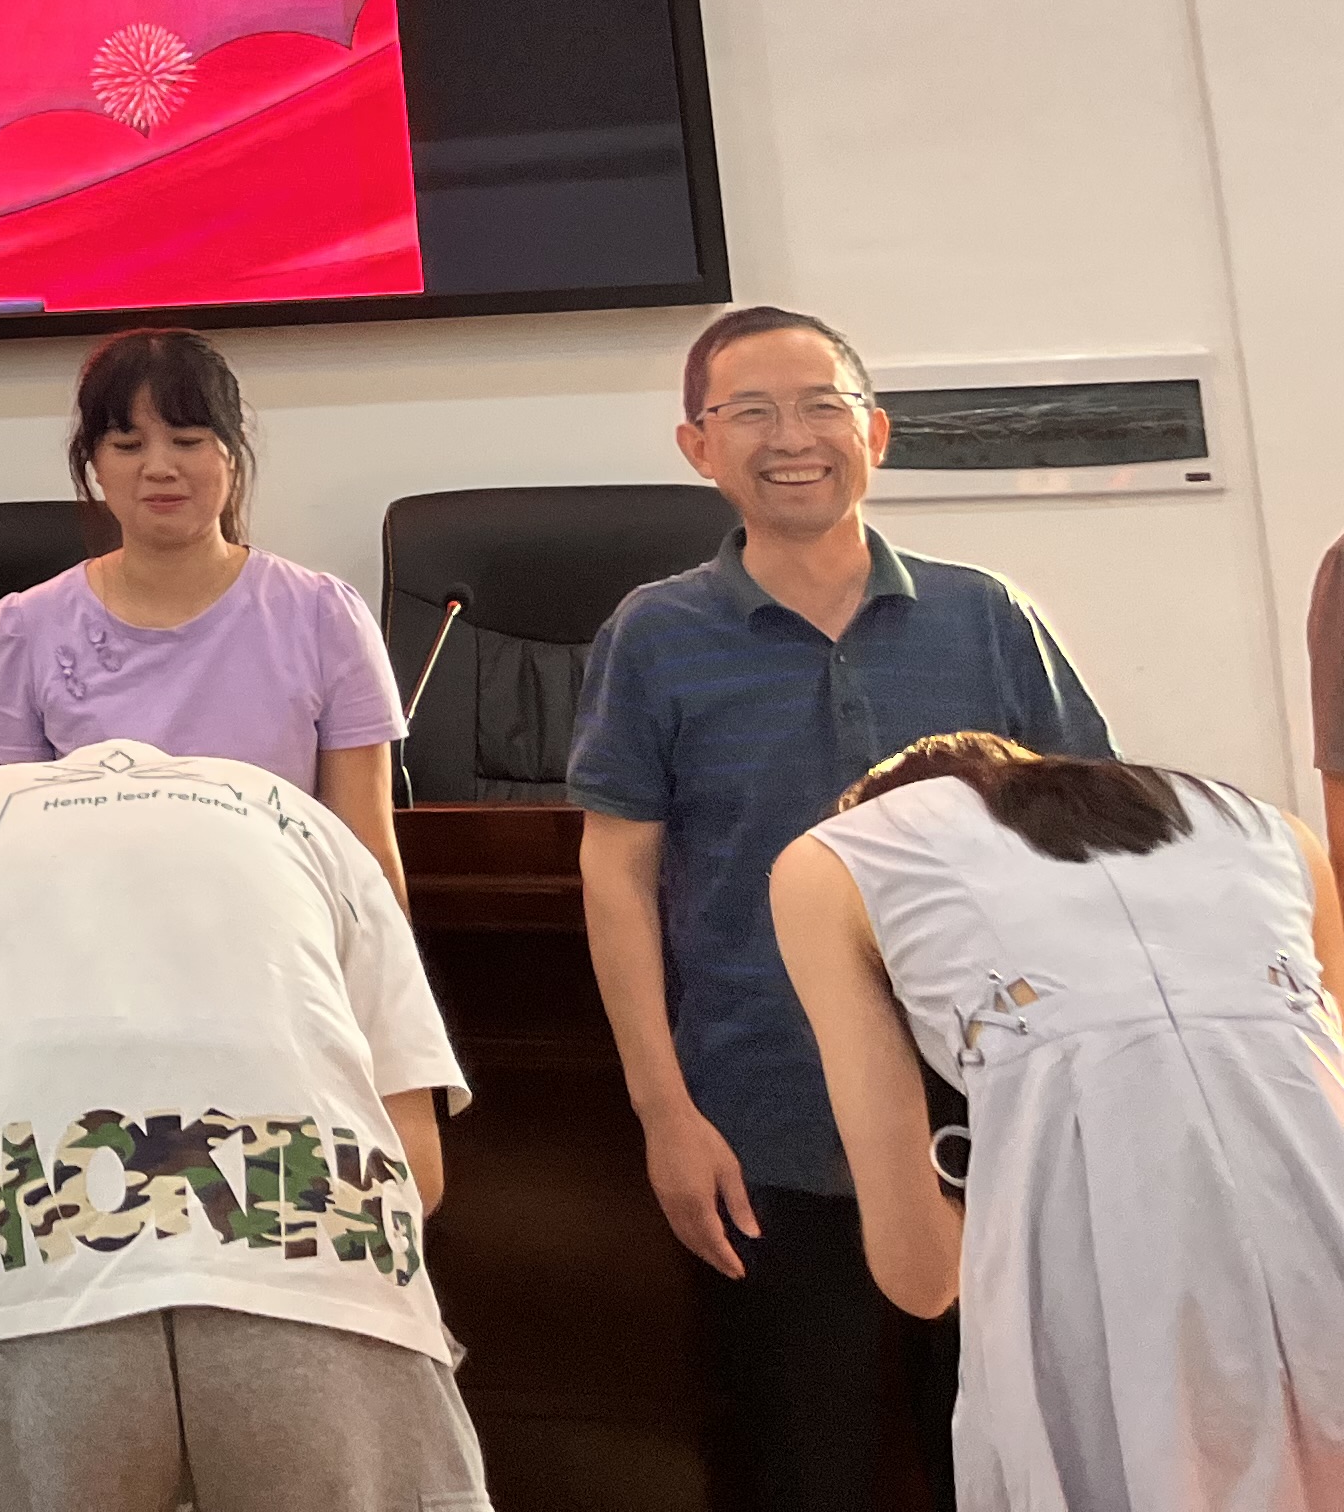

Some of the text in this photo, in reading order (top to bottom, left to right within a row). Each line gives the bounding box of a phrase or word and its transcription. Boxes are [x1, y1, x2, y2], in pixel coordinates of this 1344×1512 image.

[43, 789, 248, 816] Hemp leaf related
